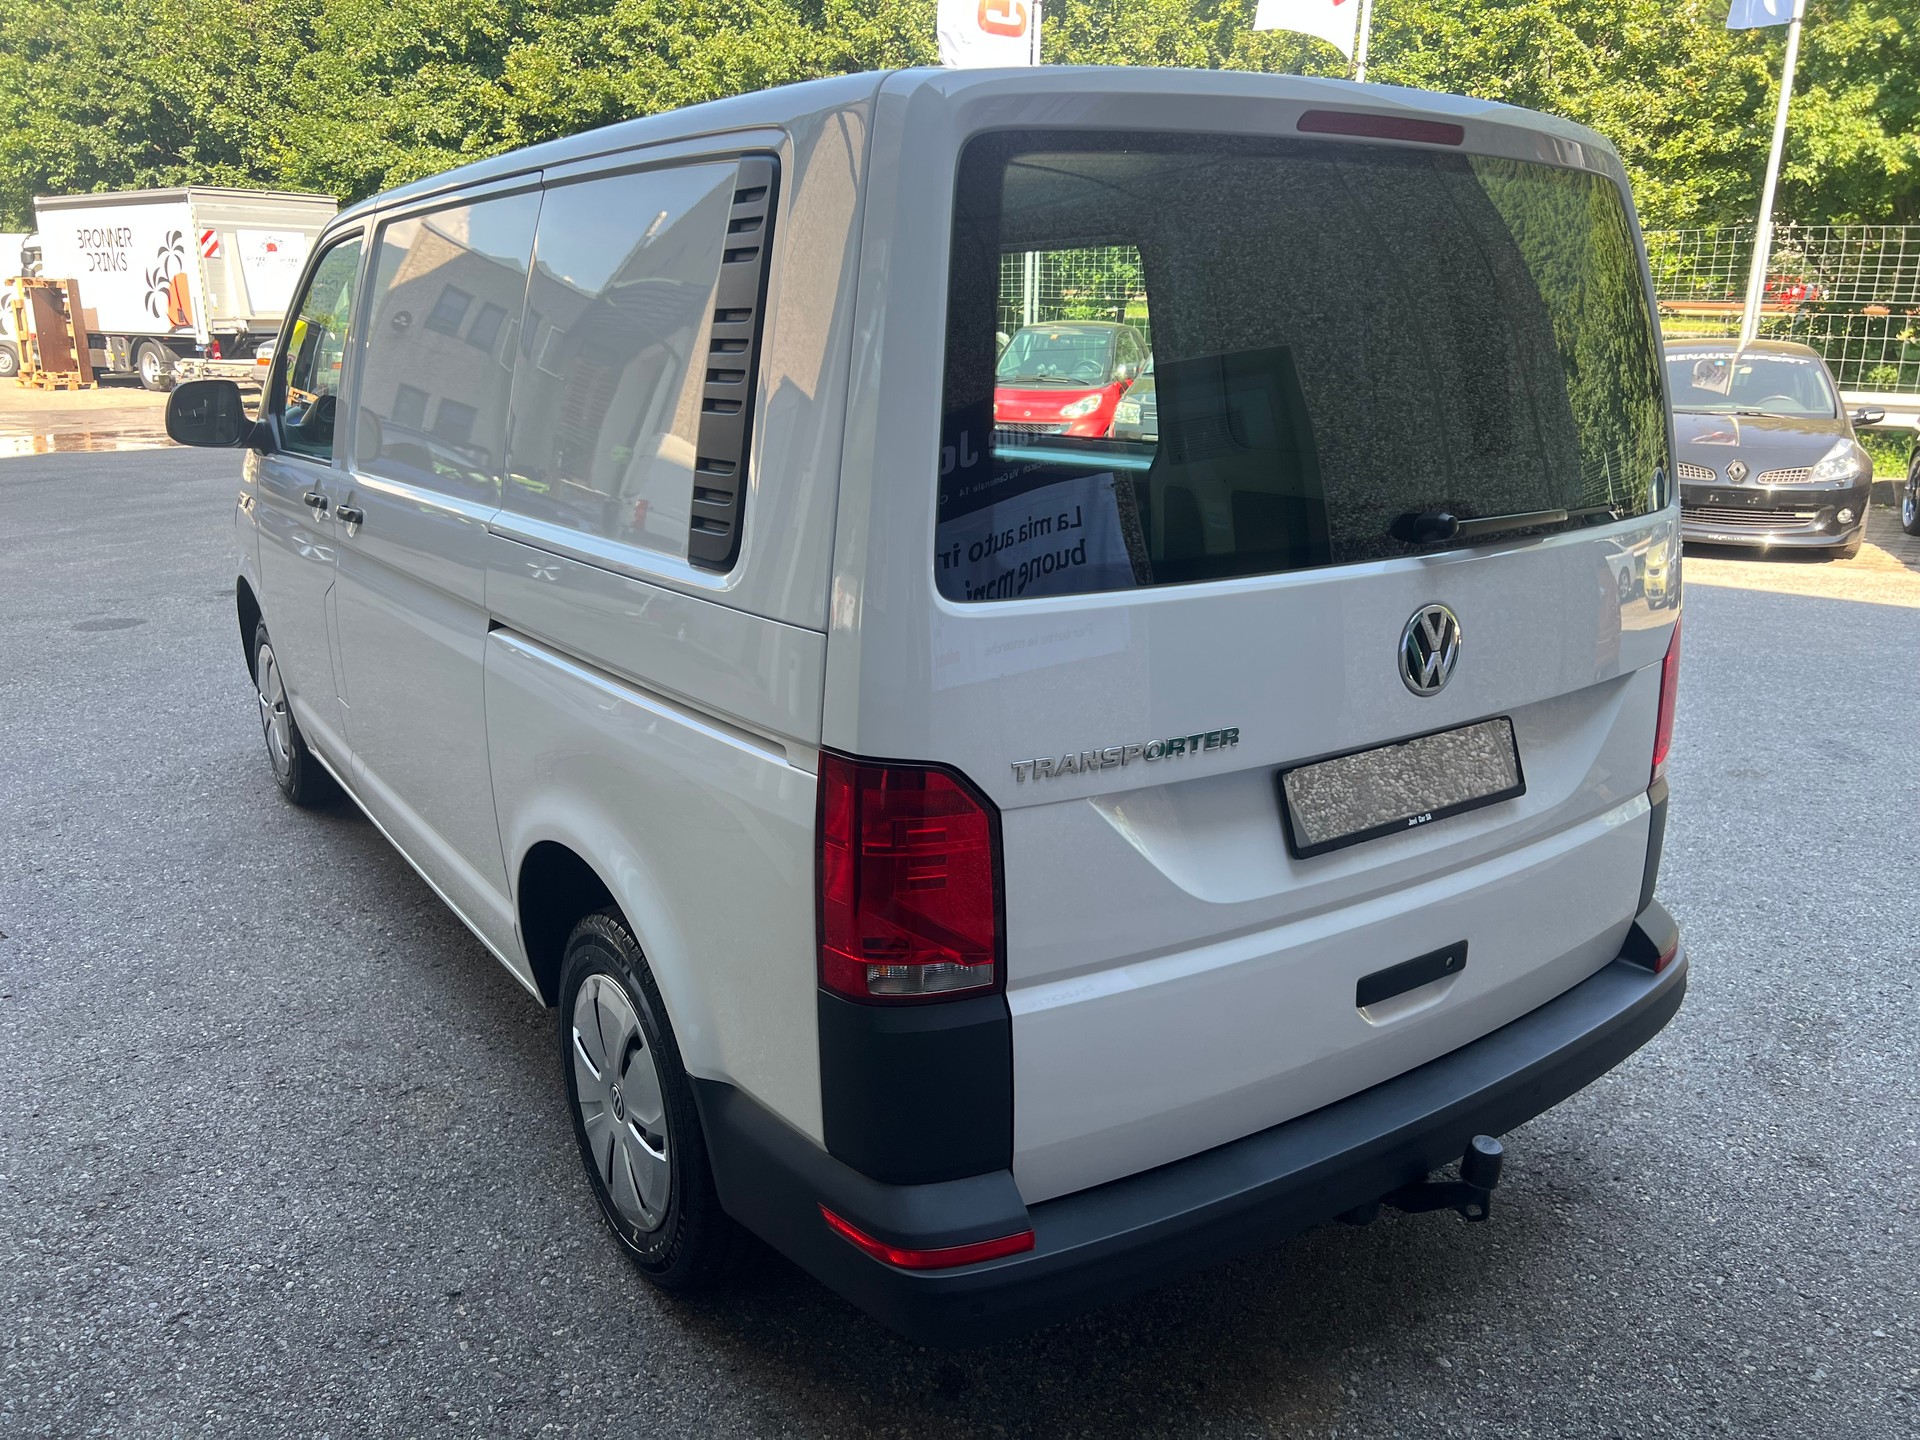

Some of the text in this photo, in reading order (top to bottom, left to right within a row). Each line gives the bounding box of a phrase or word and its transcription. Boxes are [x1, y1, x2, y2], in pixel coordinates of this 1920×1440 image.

[77, 227, 133, 249] BRONNER
[87, 252, 128, 272] DRINKS
[1665, 353, 1810, 365] RENAULT SPORT
[1010, 726, 1240, 784] TRANSPORTER
